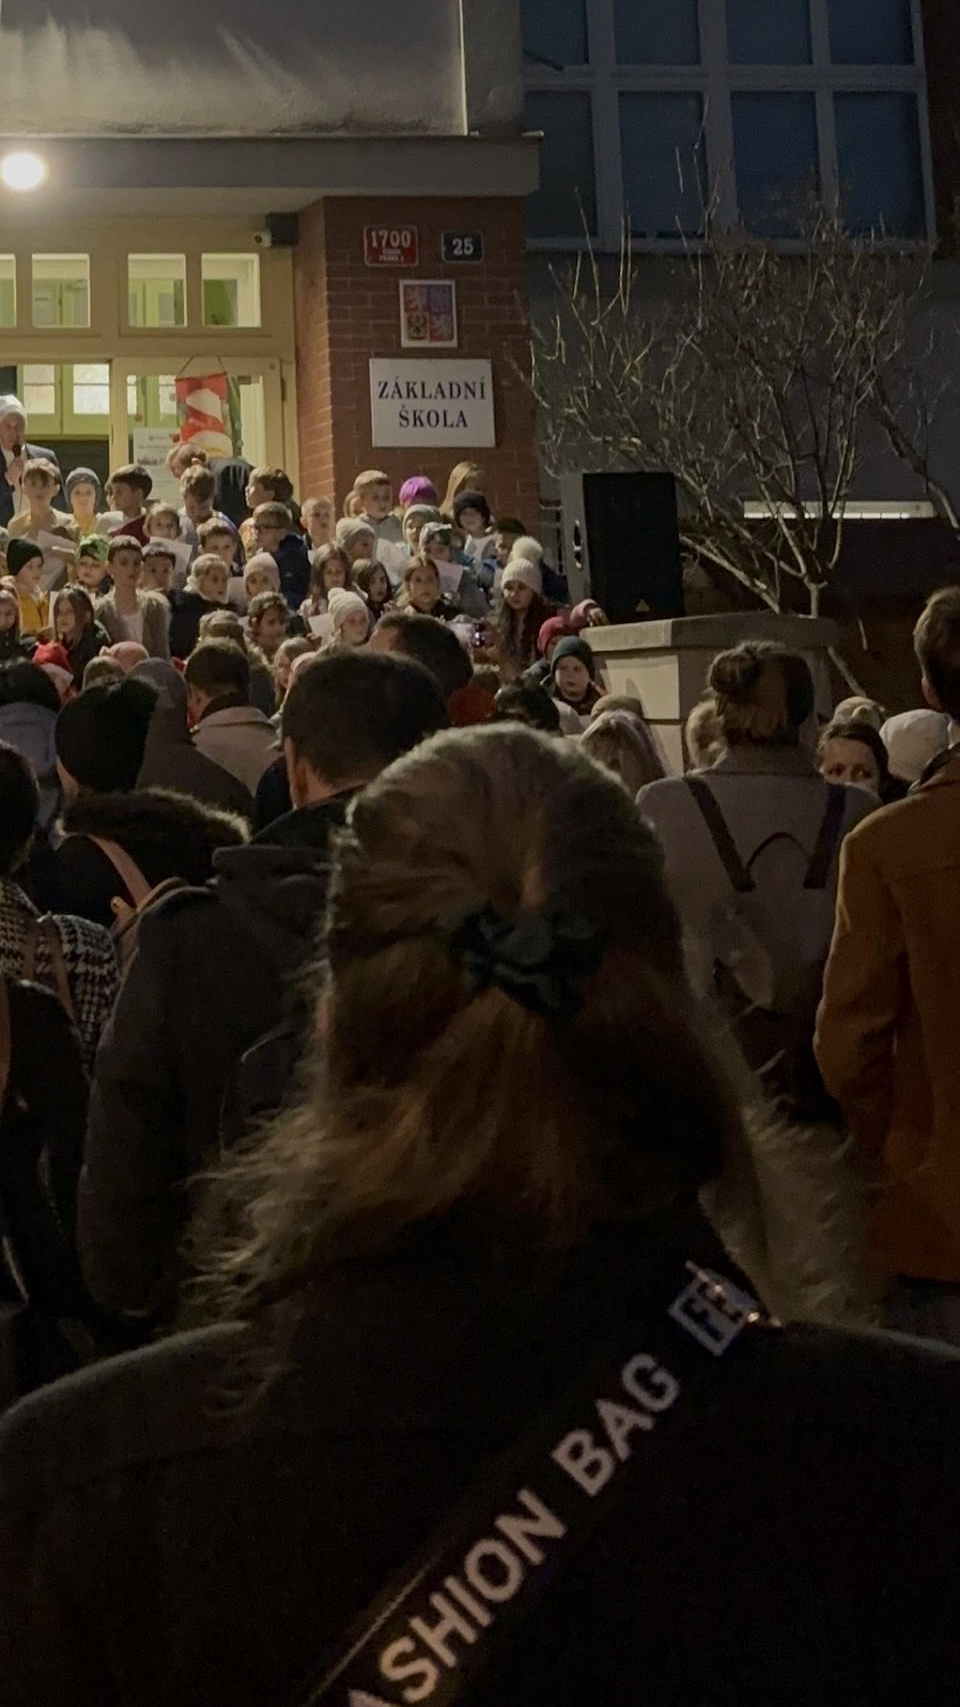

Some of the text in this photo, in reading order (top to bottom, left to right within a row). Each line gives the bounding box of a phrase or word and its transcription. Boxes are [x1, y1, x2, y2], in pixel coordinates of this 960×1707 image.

[371, 230, 411, 248] 1700
[452, 238, 474, 256] 25
[377, 375, 487, 400] ZÁKLADNÍ
[398, 404, 469, 428] ŠKOLA
[550, 1353, 680, 1496] BAG
